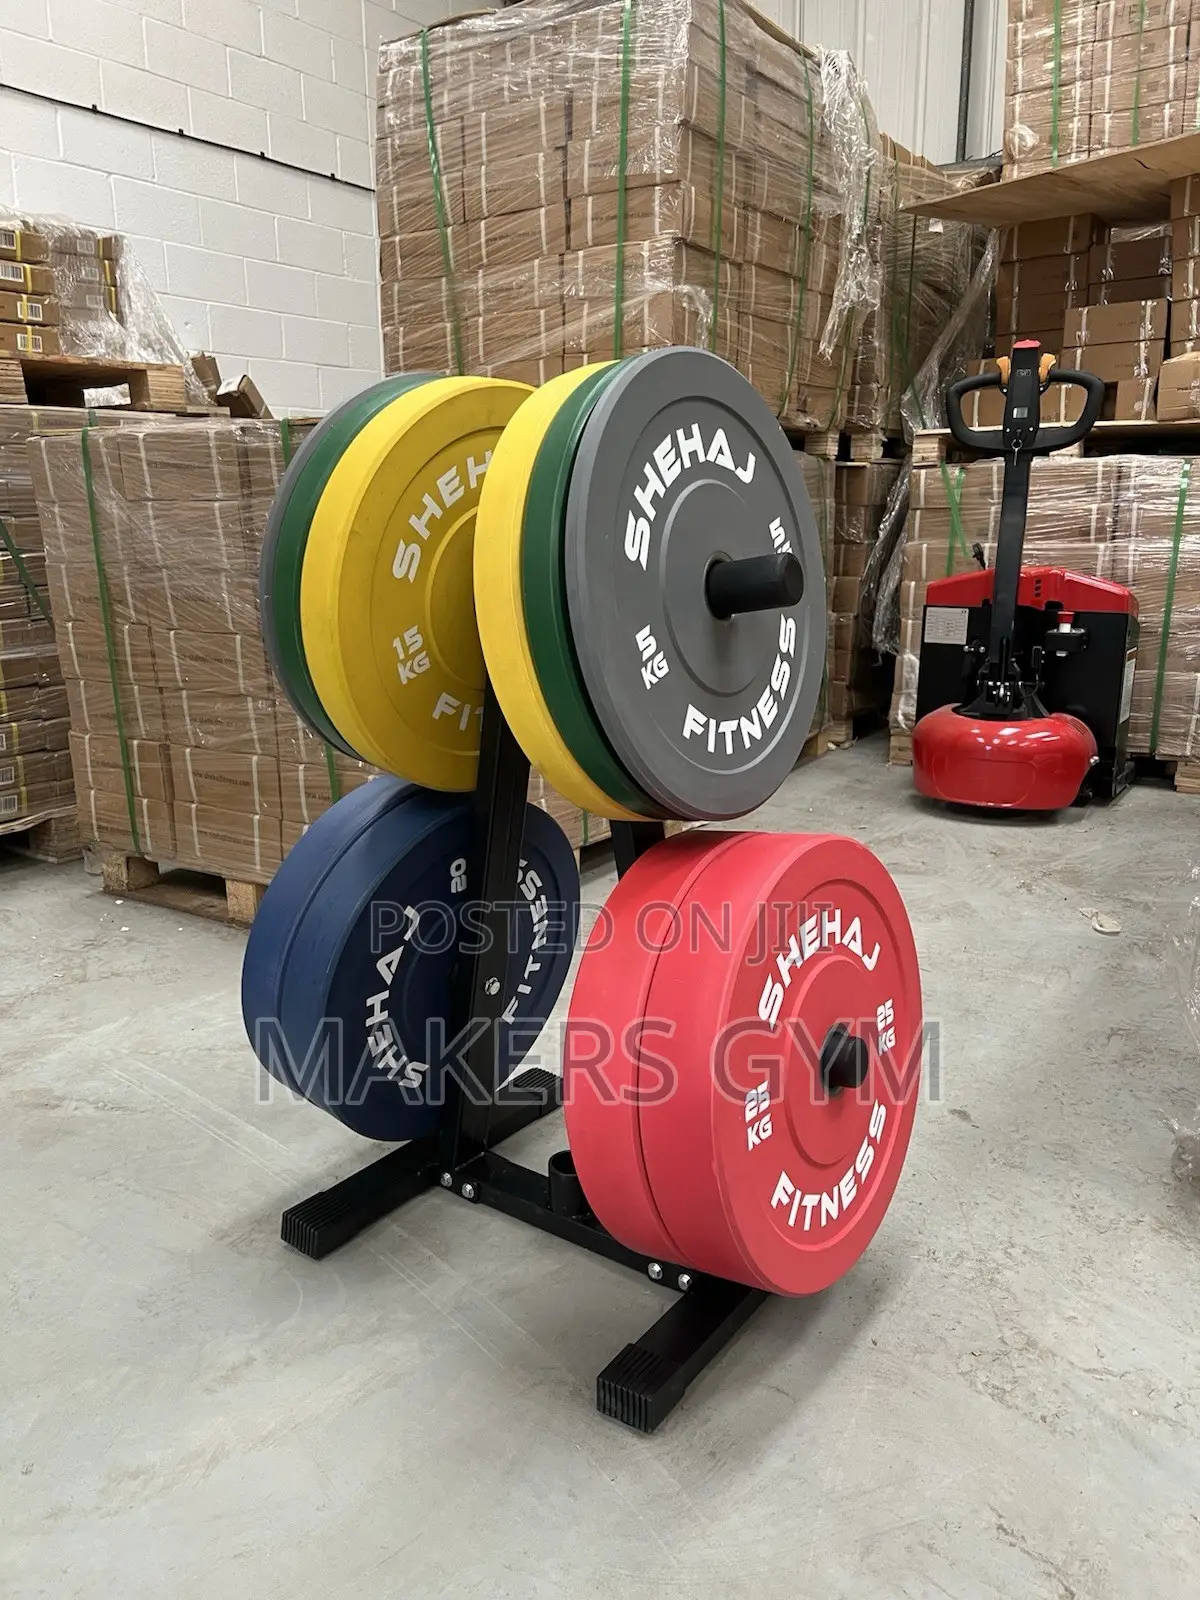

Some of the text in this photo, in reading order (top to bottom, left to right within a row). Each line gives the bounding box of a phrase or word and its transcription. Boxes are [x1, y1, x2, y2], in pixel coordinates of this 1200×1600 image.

[624, 423, 756, 571] SHEHAJ
[769, 516, 786, 549] 5
[392, 625, 424, 661] 15
[635, 624, 658, 662] 5
[396, 650, 431, 685] KG
[640, 651, 670, 690] KG
[682, 613, 797, 755] FITNESS
[450, 858, 467, 894] 20
[501, 858, 549, 1025] FITNES
[758, 909, 881, 1031] SHEHAJ
[365, 905, 430, 1088] SHEHAJ
[876, 999, 895, 1032] 25
[877, 1026, 896, 1056] KG
[744, 1080, 771, 1124] 25
[746, 1115, 774, 1151] KG
[770, 1099, 887, 1231] FITNESS
